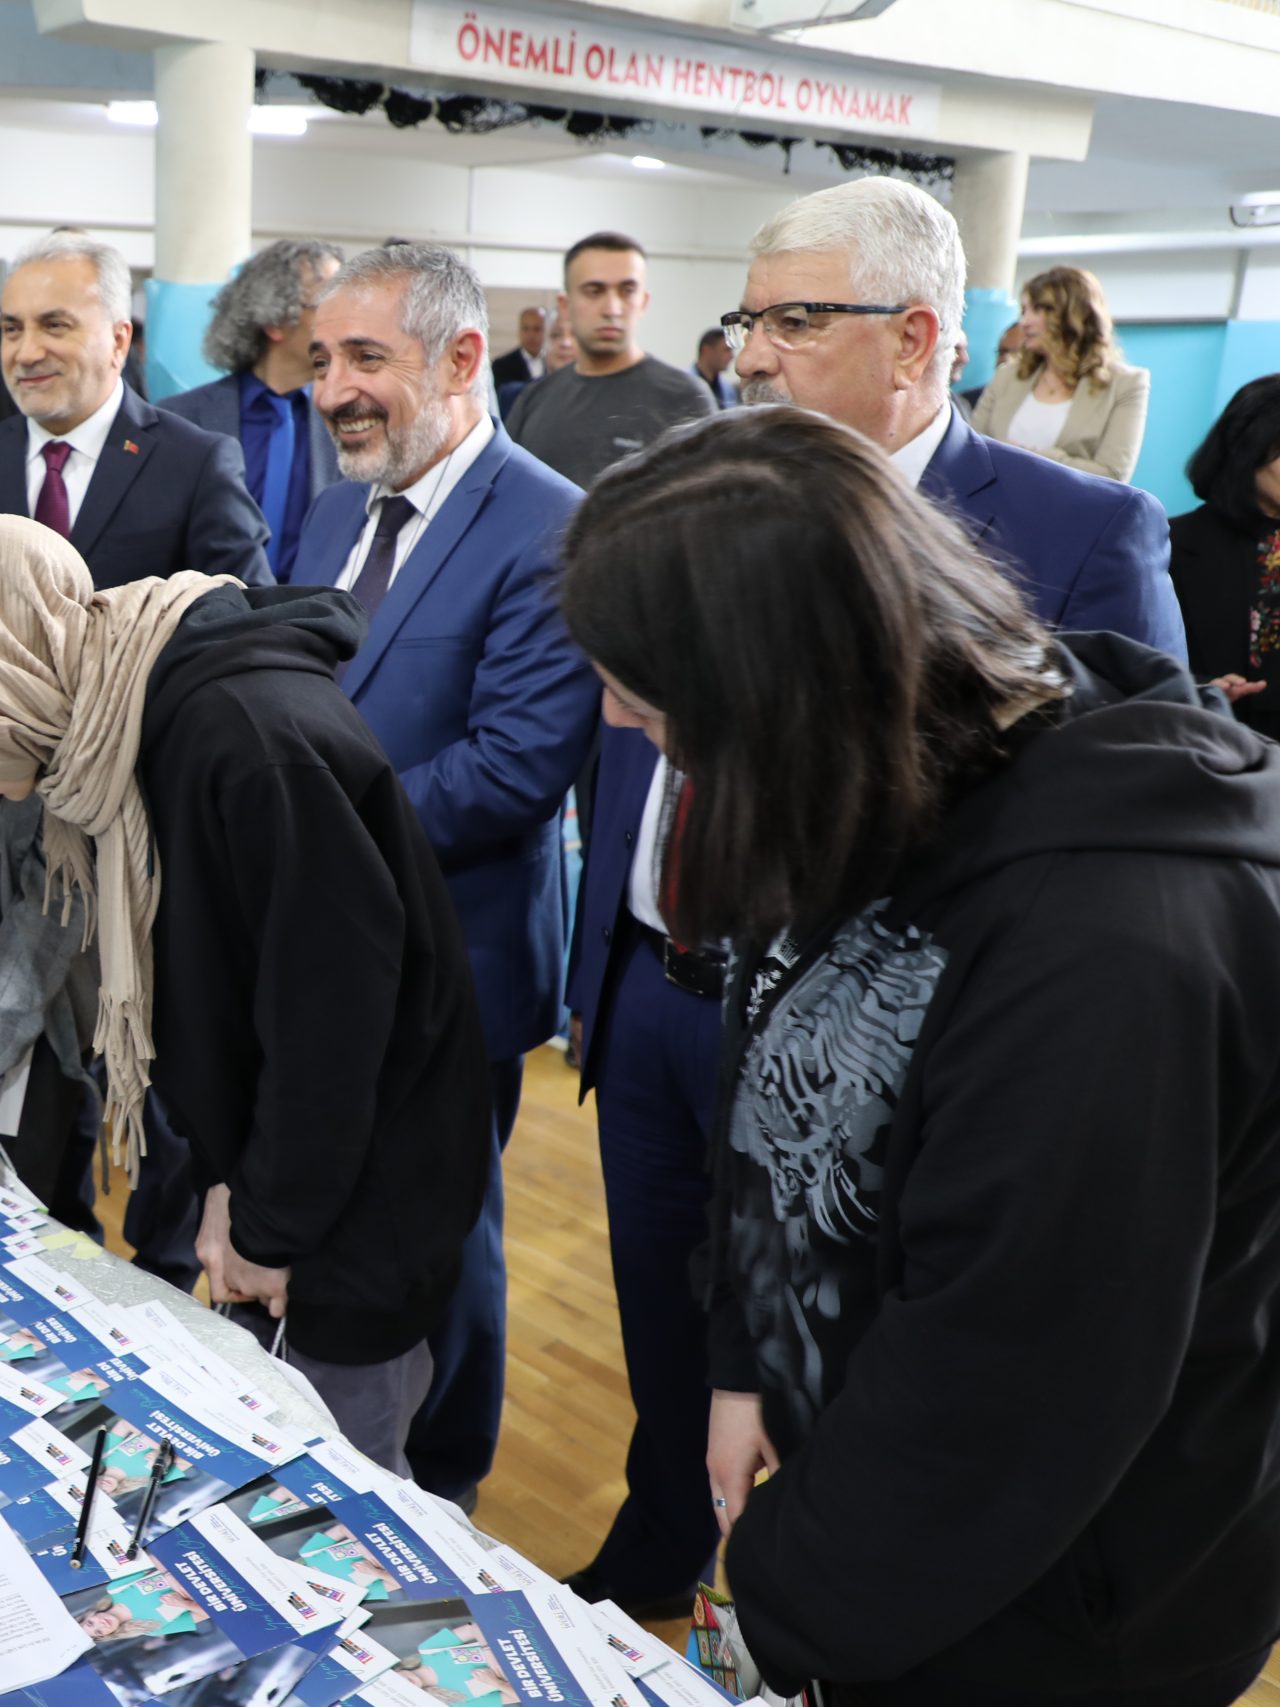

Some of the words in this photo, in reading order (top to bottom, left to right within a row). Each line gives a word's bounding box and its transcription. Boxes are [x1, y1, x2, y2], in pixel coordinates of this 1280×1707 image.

[456, 12, 576, 76] ÖNEMLİ
[585, 43, 663, 88] OLAN
[673, 60, 787, 110] HENTBOL
[795, 79, 914, 126] OYNAMAK
[146, 1422, 188, 1451] DEVLET
[149, 1410, 221, 1457] ÜNİVERSİTESİ
[183, 1447, 205, 1460] BİR
[365, 1532, 404, 1571] DEVLET
[372, 1522, 438, 1584] ÜNİVERSİTESİ
[174, 1562, 213, 1599] DEVLET
[182, 1551, 247, 1612] ÜNİVERSİTESİ
[397, 1565, 419, 1583] BİR
[205, 1593, 228, 1612] BİR
[497, 1638, 532, 1680] DEVLET
[508, 1629, 565, 1702] ÜNİVERSİTESİ
[522, 1678, 543, 1699] BİR
